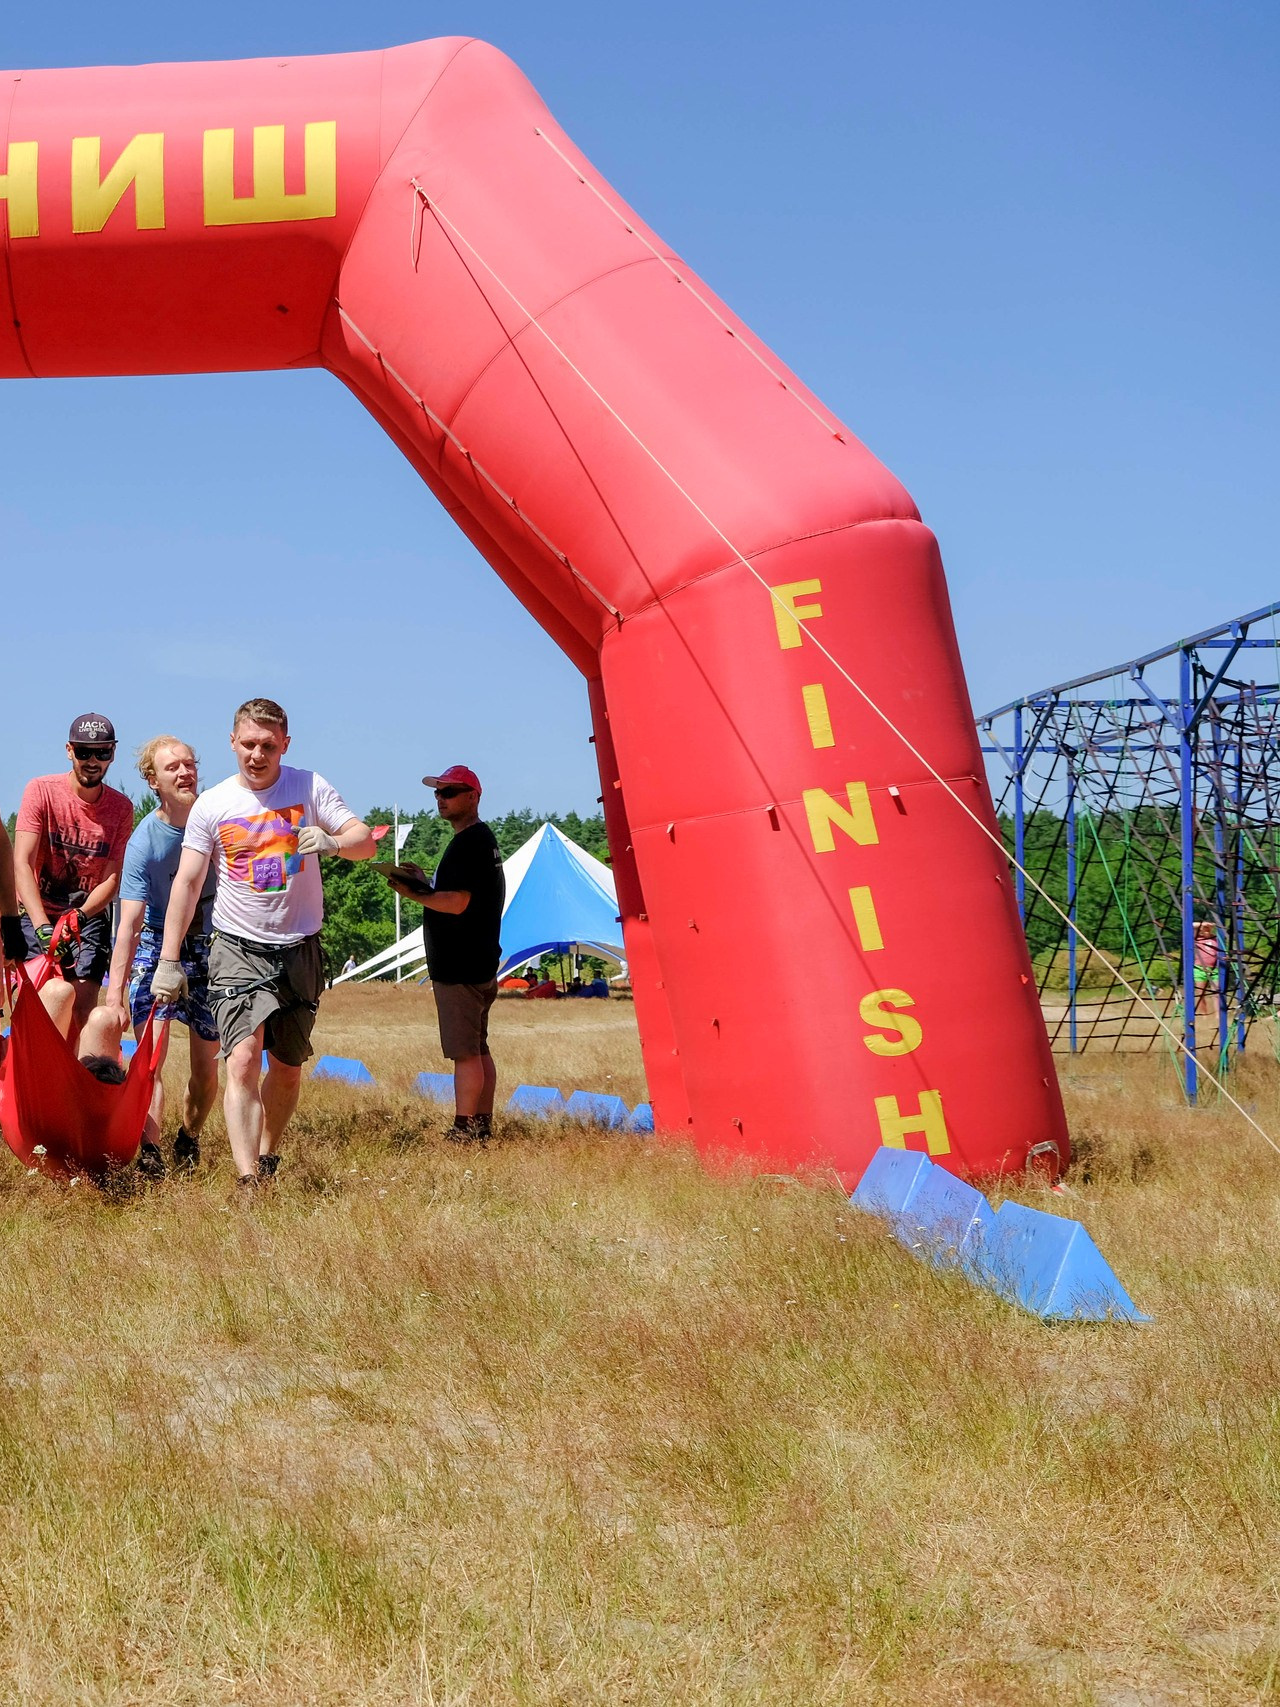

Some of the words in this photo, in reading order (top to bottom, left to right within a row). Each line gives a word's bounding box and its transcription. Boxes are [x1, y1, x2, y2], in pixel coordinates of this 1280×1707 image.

[78, 721, 106, 729] JACK
[255, 862, 278, 871] PRO
[770, 578, 952, 1156] FINISH
